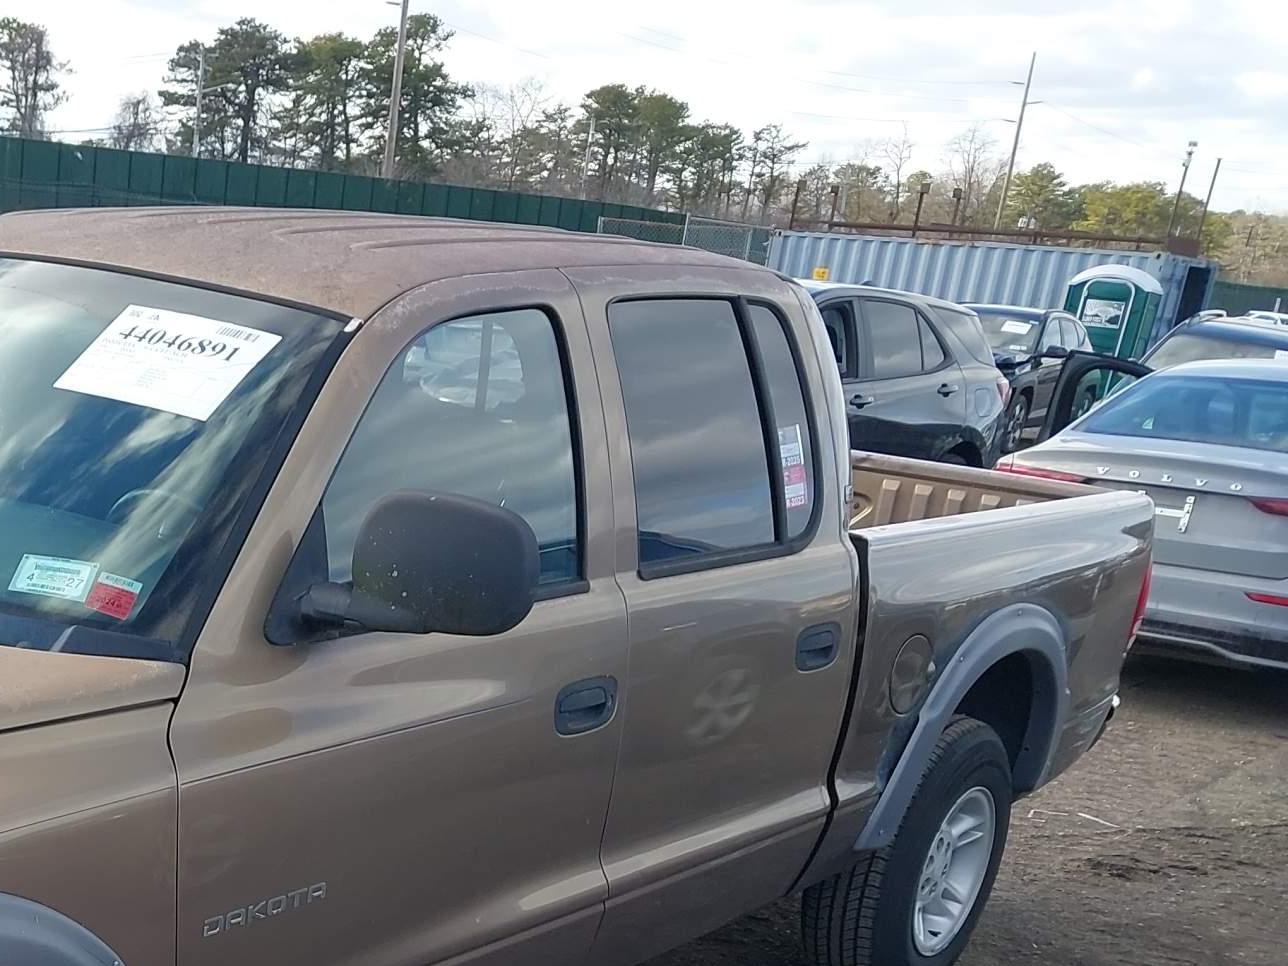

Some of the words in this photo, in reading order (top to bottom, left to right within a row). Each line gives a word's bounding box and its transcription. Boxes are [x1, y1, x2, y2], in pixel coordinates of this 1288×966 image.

[119, 324, 241, 362] 44046891
[1096, 466, 1242, 491] VOLVO
[202, 881, 328, 937] DAKOTA
